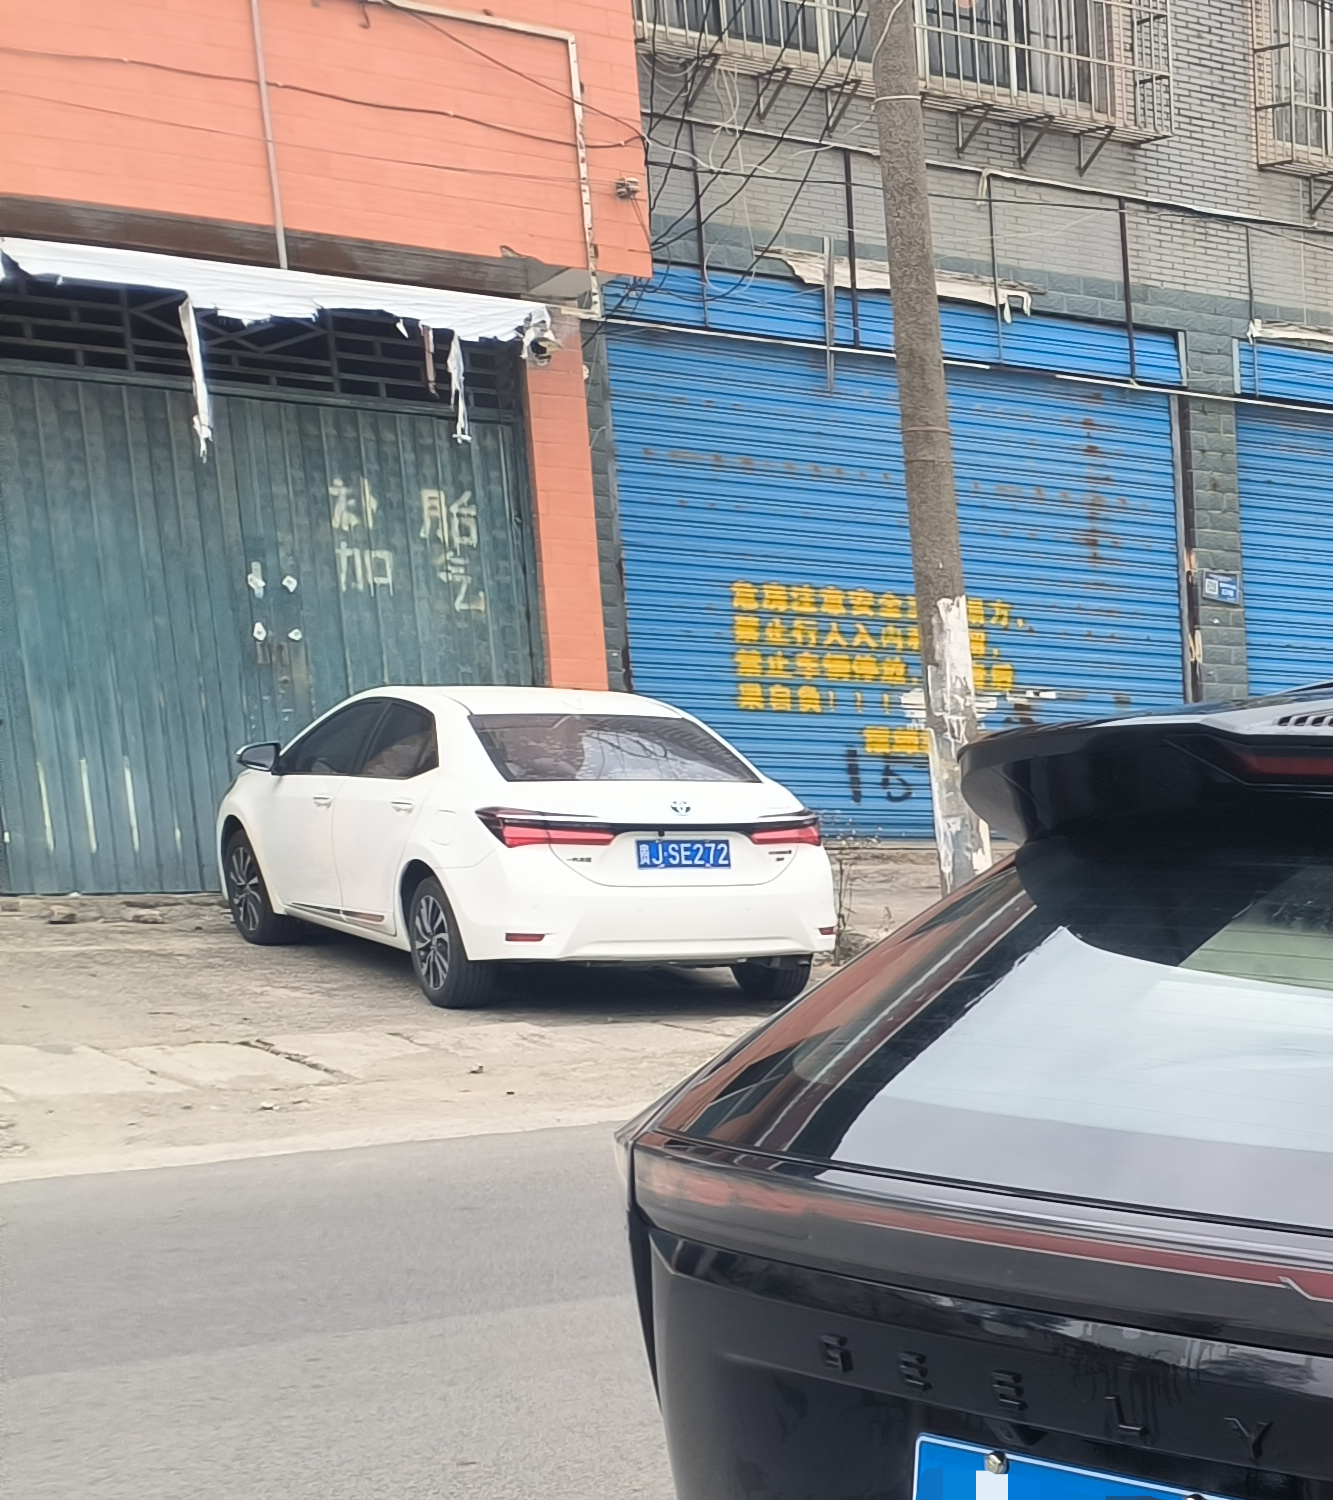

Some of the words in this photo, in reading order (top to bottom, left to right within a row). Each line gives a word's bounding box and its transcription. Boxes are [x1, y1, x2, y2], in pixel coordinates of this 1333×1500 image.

[328, 477, 479, 550] 补胎
[334, 541, 486, 612] 加气
[819, 1333, 1274, 1461] GEELY
